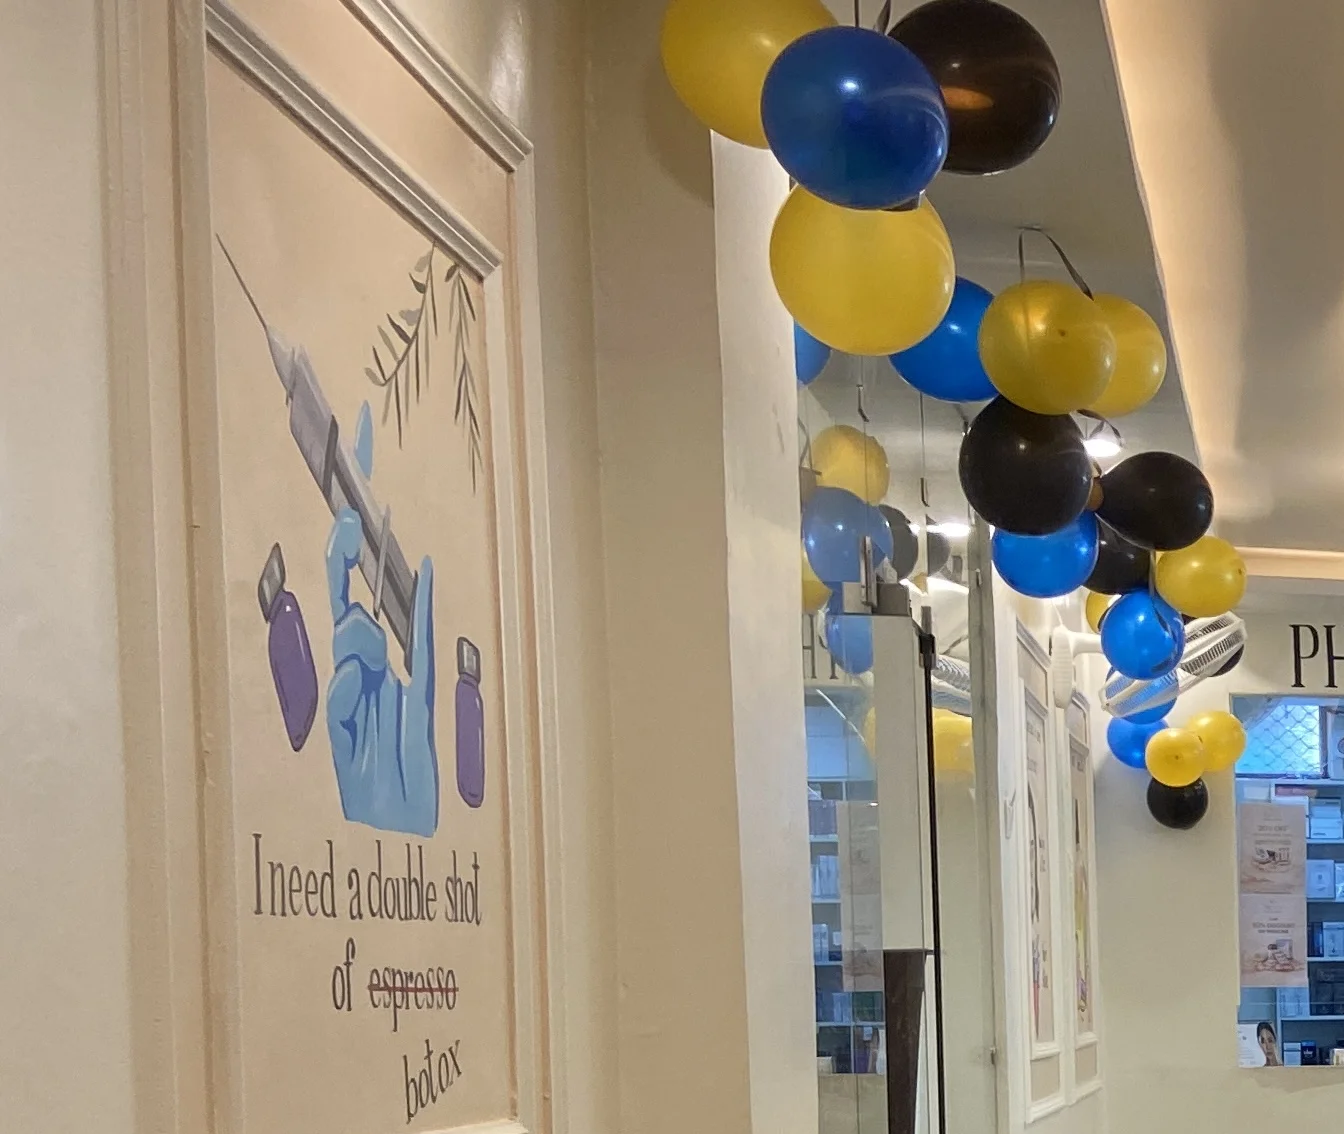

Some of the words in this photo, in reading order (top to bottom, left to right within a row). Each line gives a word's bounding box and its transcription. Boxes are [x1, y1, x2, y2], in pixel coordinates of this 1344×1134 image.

[252, 833, 264, 916] I
[268, 839, 338, 918] need
[347, 866, 364, 921] a
[367, 839, 438, 922] double
[445, 849, 483, 927] shot
[331, 937, 356, 1012] of
[368, 965, 458, 1032] espresso
[403, 1039, 463, 1125] botox
